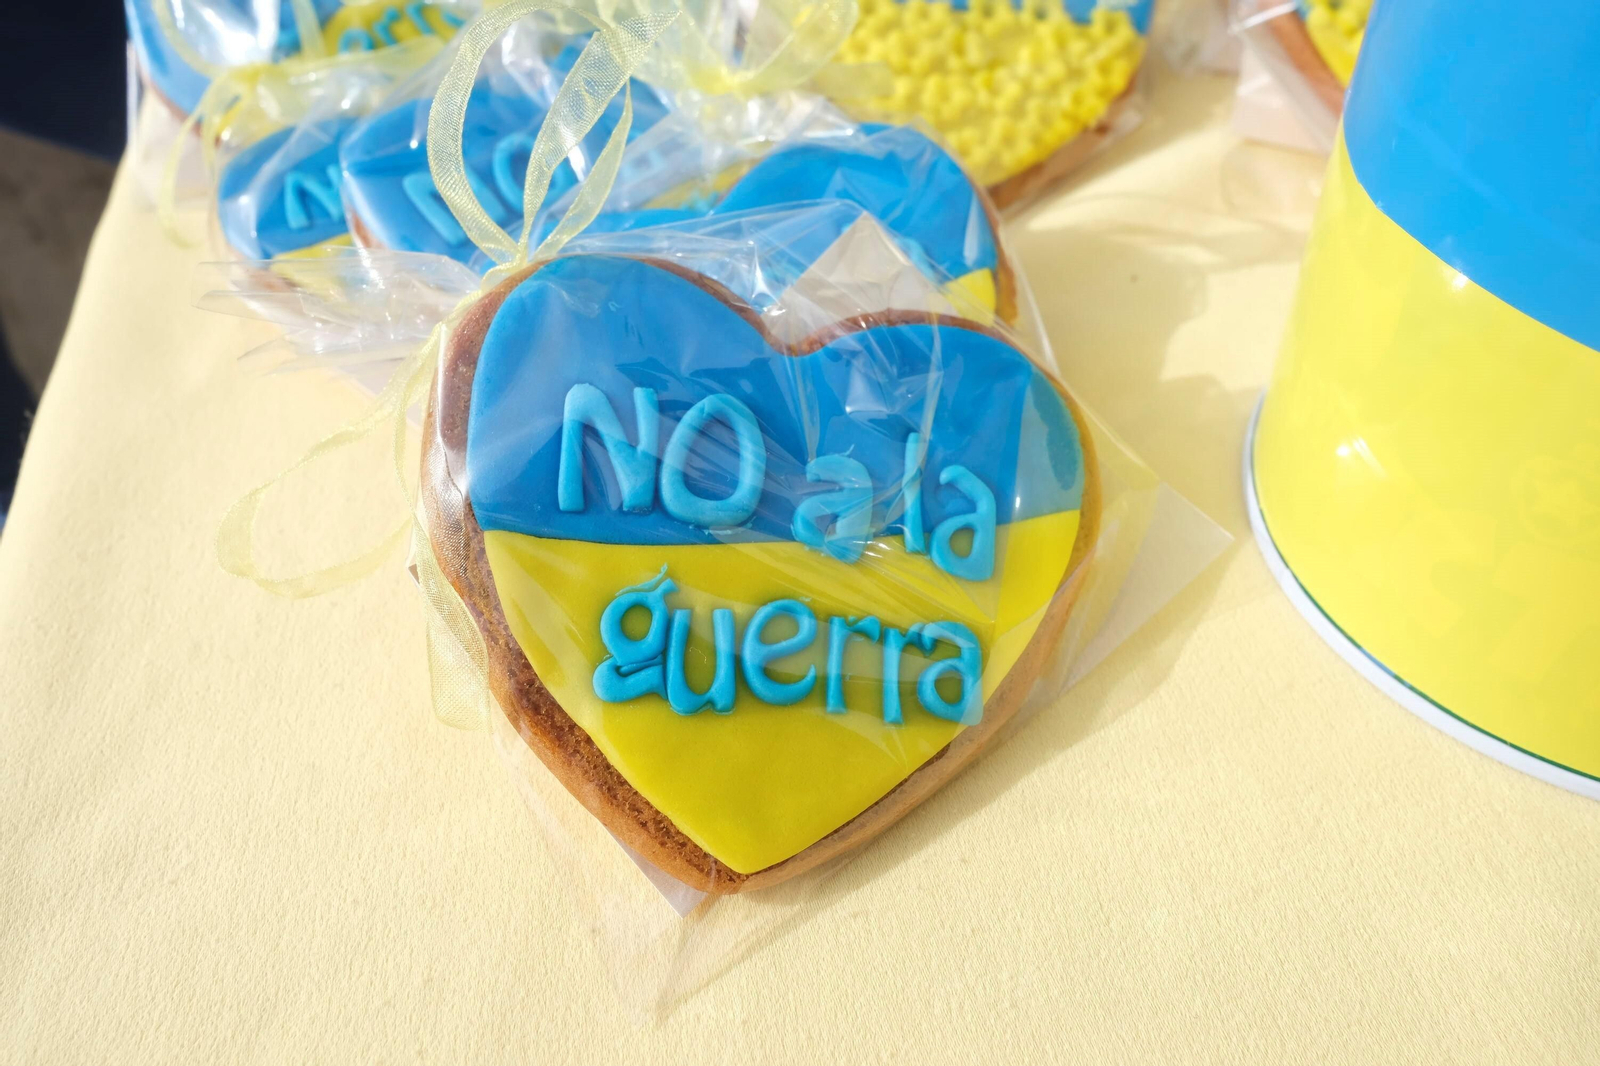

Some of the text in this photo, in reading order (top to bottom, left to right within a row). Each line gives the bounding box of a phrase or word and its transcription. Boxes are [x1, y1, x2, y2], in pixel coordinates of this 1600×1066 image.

[557, 382, 998, 582] NO a la
[592, 564, 984, 727] guerra
